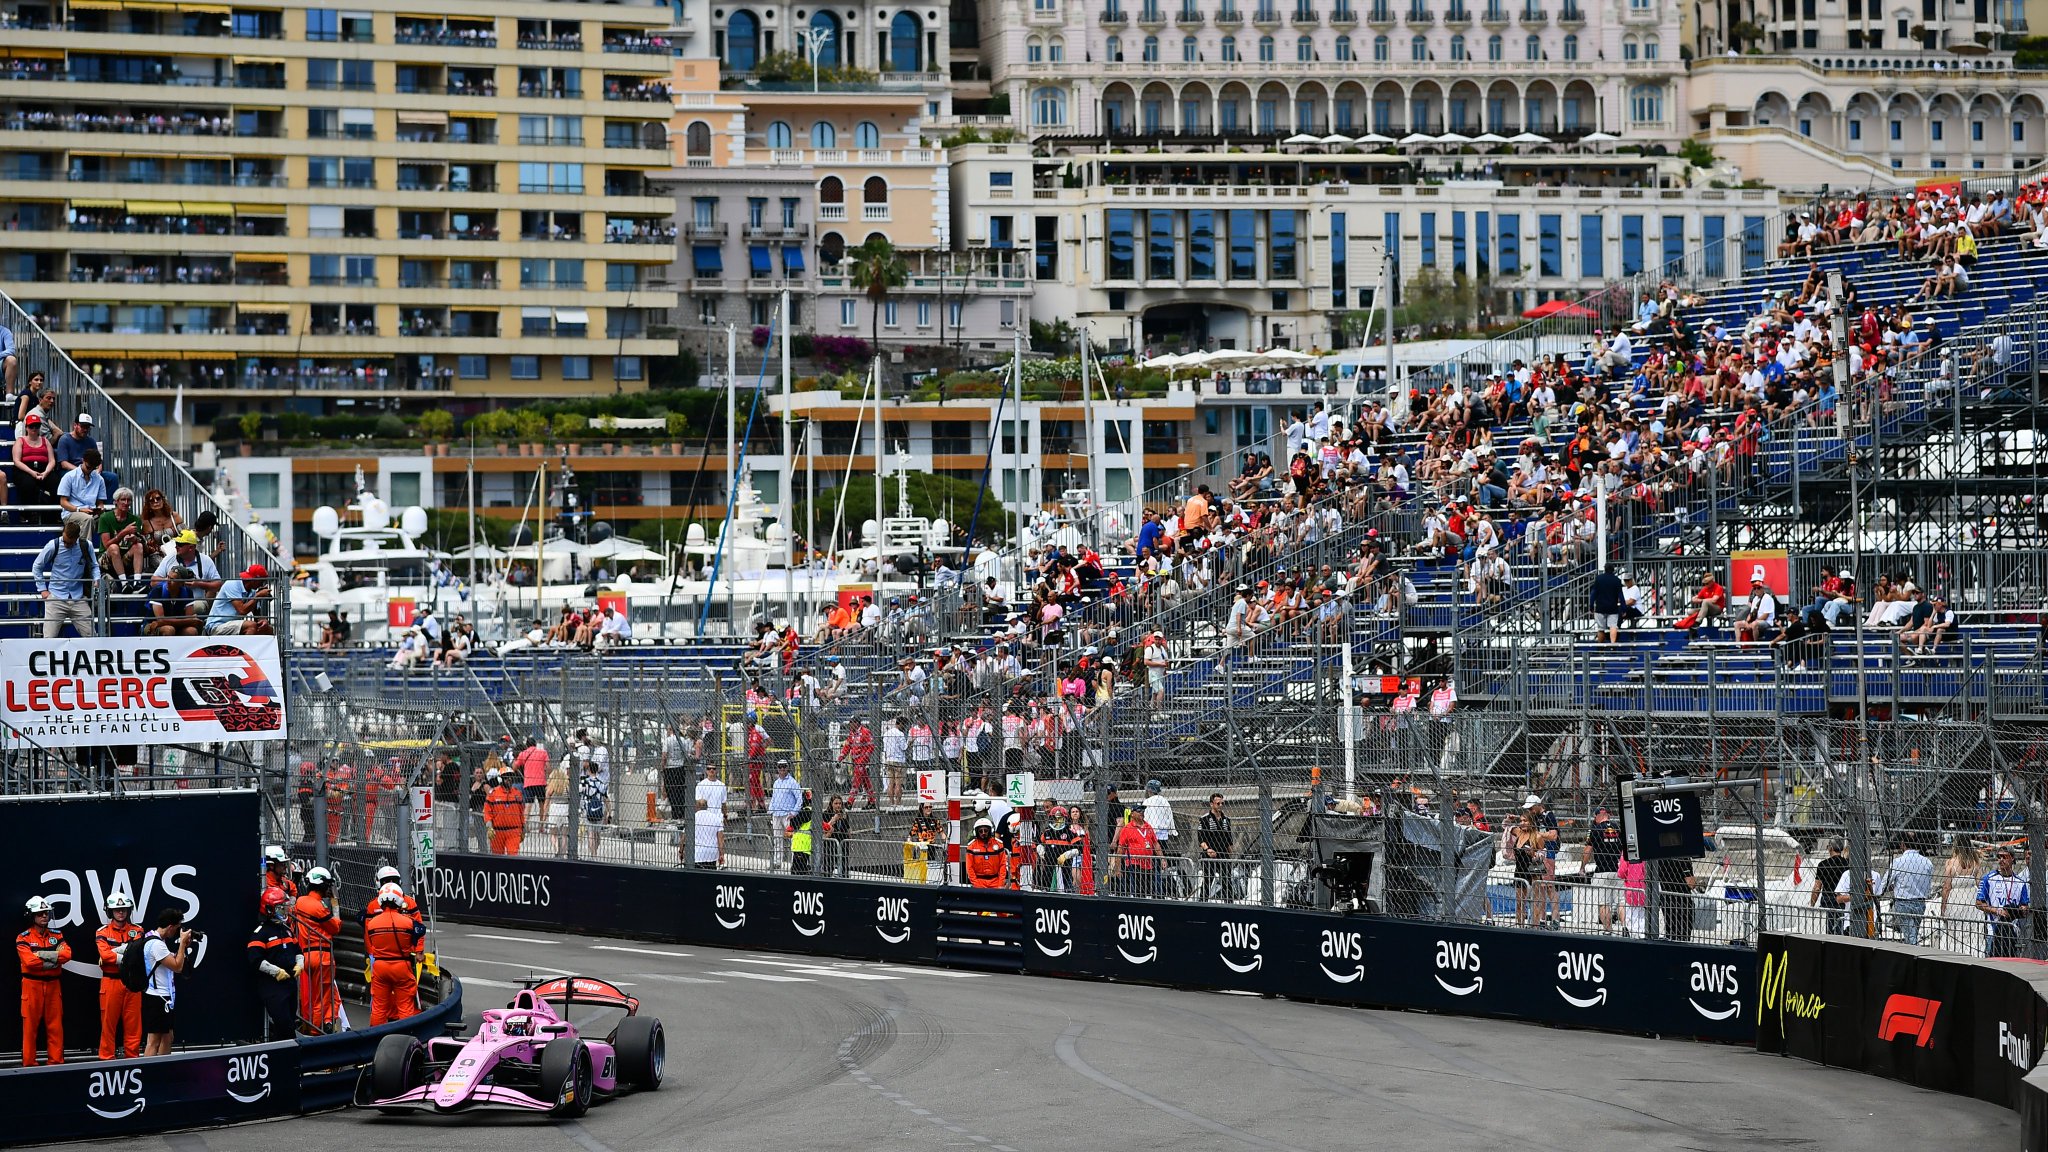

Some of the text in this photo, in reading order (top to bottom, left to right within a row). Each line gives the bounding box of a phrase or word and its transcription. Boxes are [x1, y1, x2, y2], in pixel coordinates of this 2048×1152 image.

[398, 605, 406, 624] N
[29, 649, 170, 676] CHARLES
[6, 677, 170, 712] LECLERC
[23, 722, 181, 736] MARCHE FAN CLUB
[44, 713, 160, 724] THE OFFICIAL
[1653, 798, 1682, 813] aws
[40, 864, 200, 928] aws
[411, 866, 550, 908] PLORA JOURNEYS
[716, 884, 745, 909] aws
[793, 890, 824, 916] aws
[876, 896, 910, 923] aws
[1035, 907, 1071, 935] aws
[1118, 913, 1156, 942] aws
[1221, 921, 1261, 950] aws
[1321, 929, 1363, 960] aws
[1435, 940, 1481, 972] aws
[1557, 950, 1605, 982] aws
[1690, 961, 1739, 995] aws
[560, 981, 602, 991] wdhager
[1758, 950, 1826, 1039] Monaco
[1878, 993, 1942, 1047] F1
[227, 1053, 269, 1083] aws
[88, 1068, 143, 1098] aws
